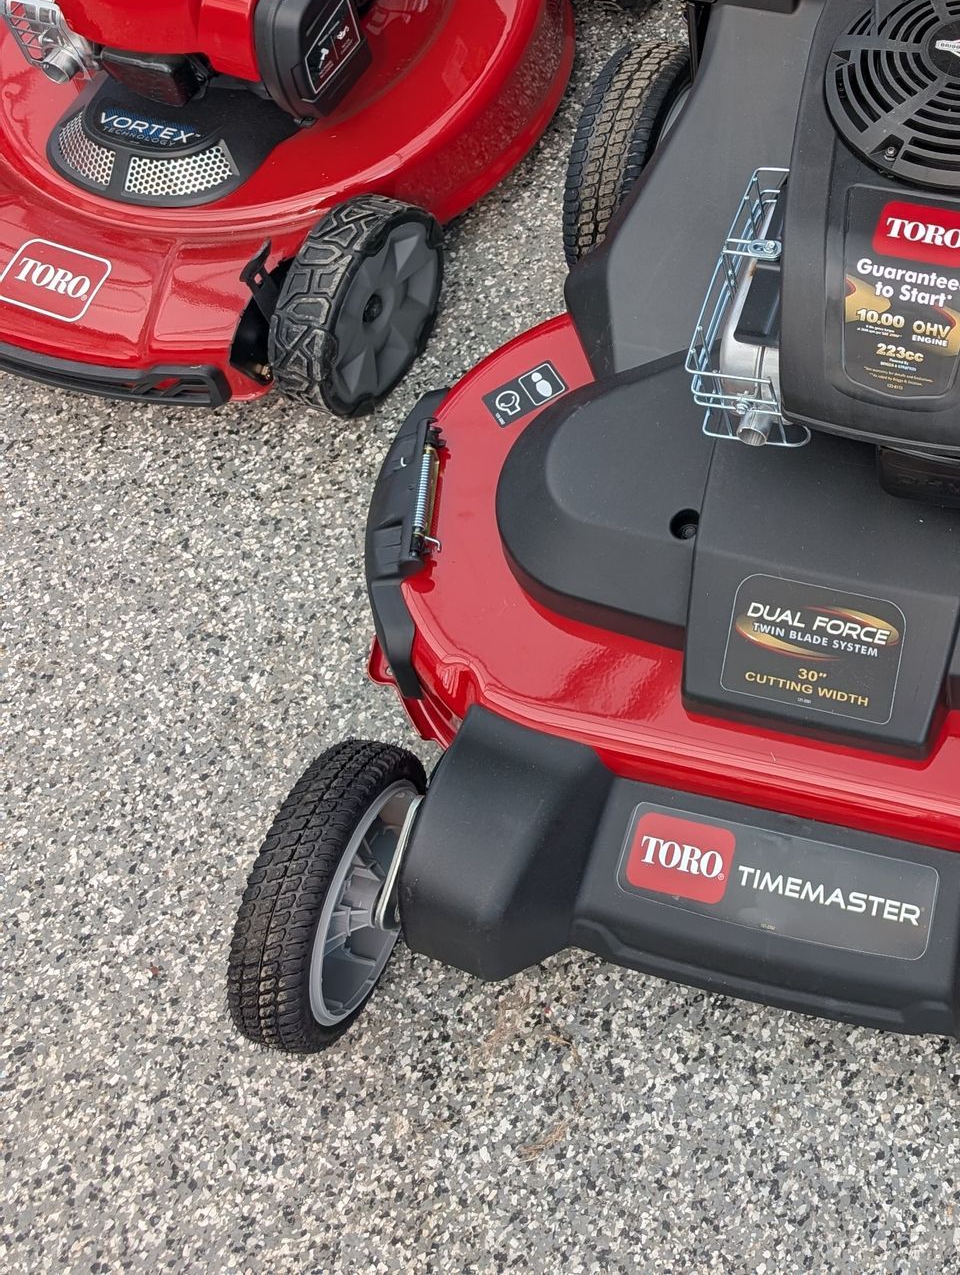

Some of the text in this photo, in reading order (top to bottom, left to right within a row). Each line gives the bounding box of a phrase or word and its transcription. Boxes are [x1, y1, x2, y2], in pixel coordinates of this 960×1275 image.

[101, 112, 194, 143] VORTEX
[102, 125, 178, 147] TECHNOLOGY
[15, 257, 90, 299] TORO
[875, 281, 894, 299] to
[857, 308, 905, 329] 10.00
[912, 320, 950, 339] OHV
[876, 343, 924, 363] 223cc
[911, 335, 948, 347] ENGINE
[747, 602, 890, 645] DUAL FORCE
[753, 622, 878, 657] TWIN BLADE SYSTEM
[745, 671, 869, 707] CUTTING WIDTH
[641, 835, 723, 878] TORO
[738, 865, 921, 926] TIMEMASTER
